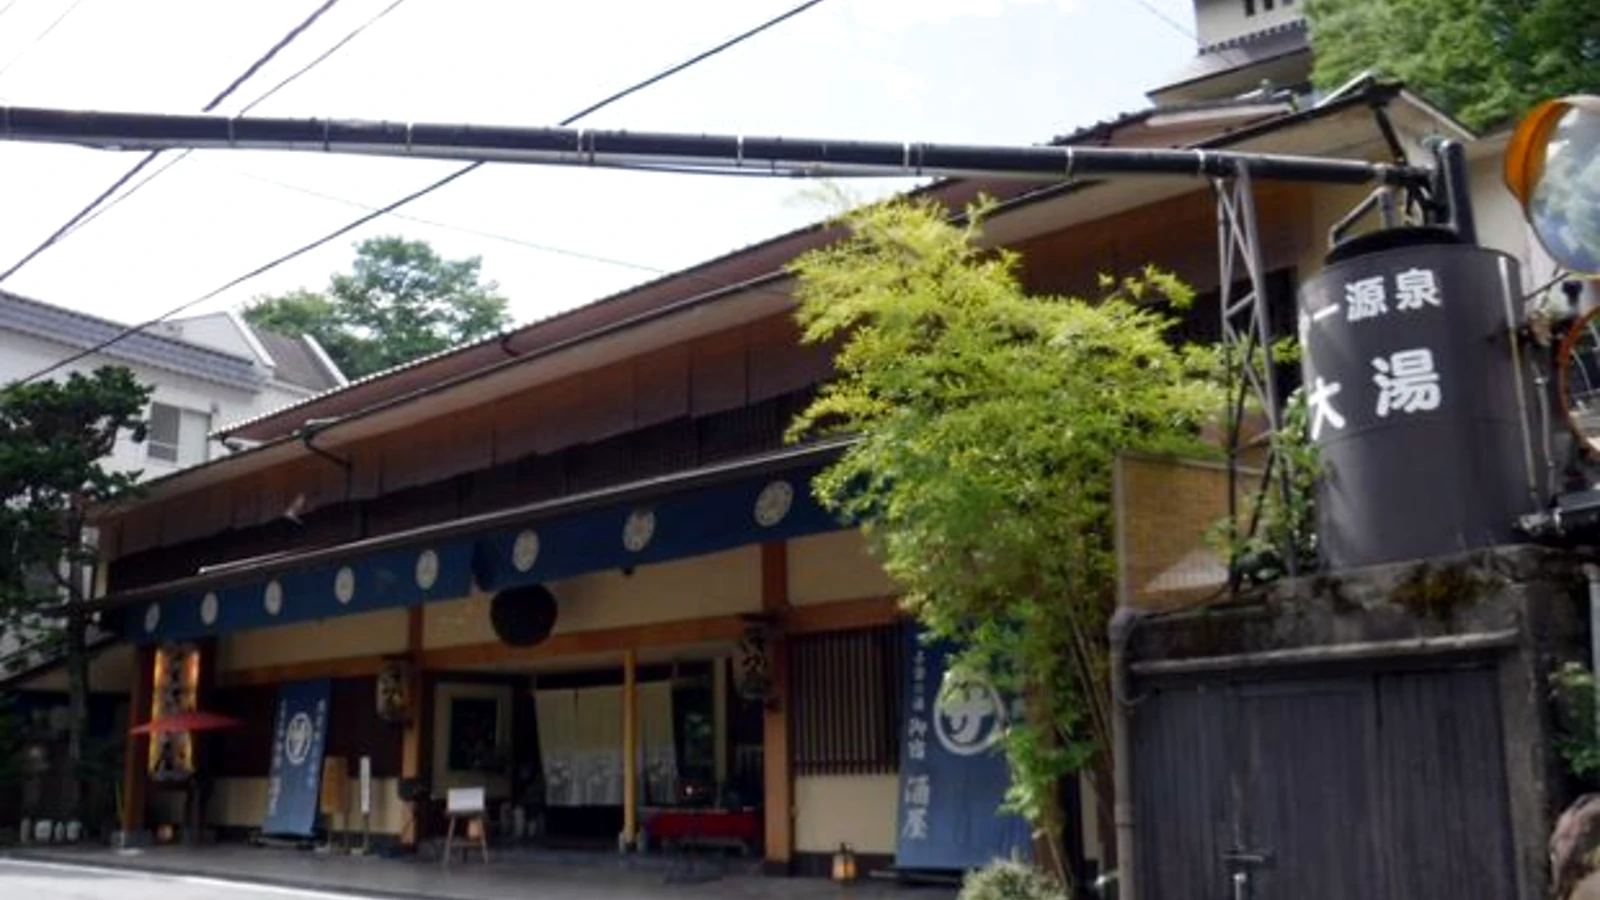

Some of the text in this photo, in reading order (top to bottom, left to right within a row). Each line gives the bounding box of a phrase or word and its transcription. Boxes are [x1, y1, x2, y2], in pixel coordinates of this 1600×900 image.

[1302, 269, 1442, 332] 一源泉
[1308, 348, 1442, 440] 大湯
